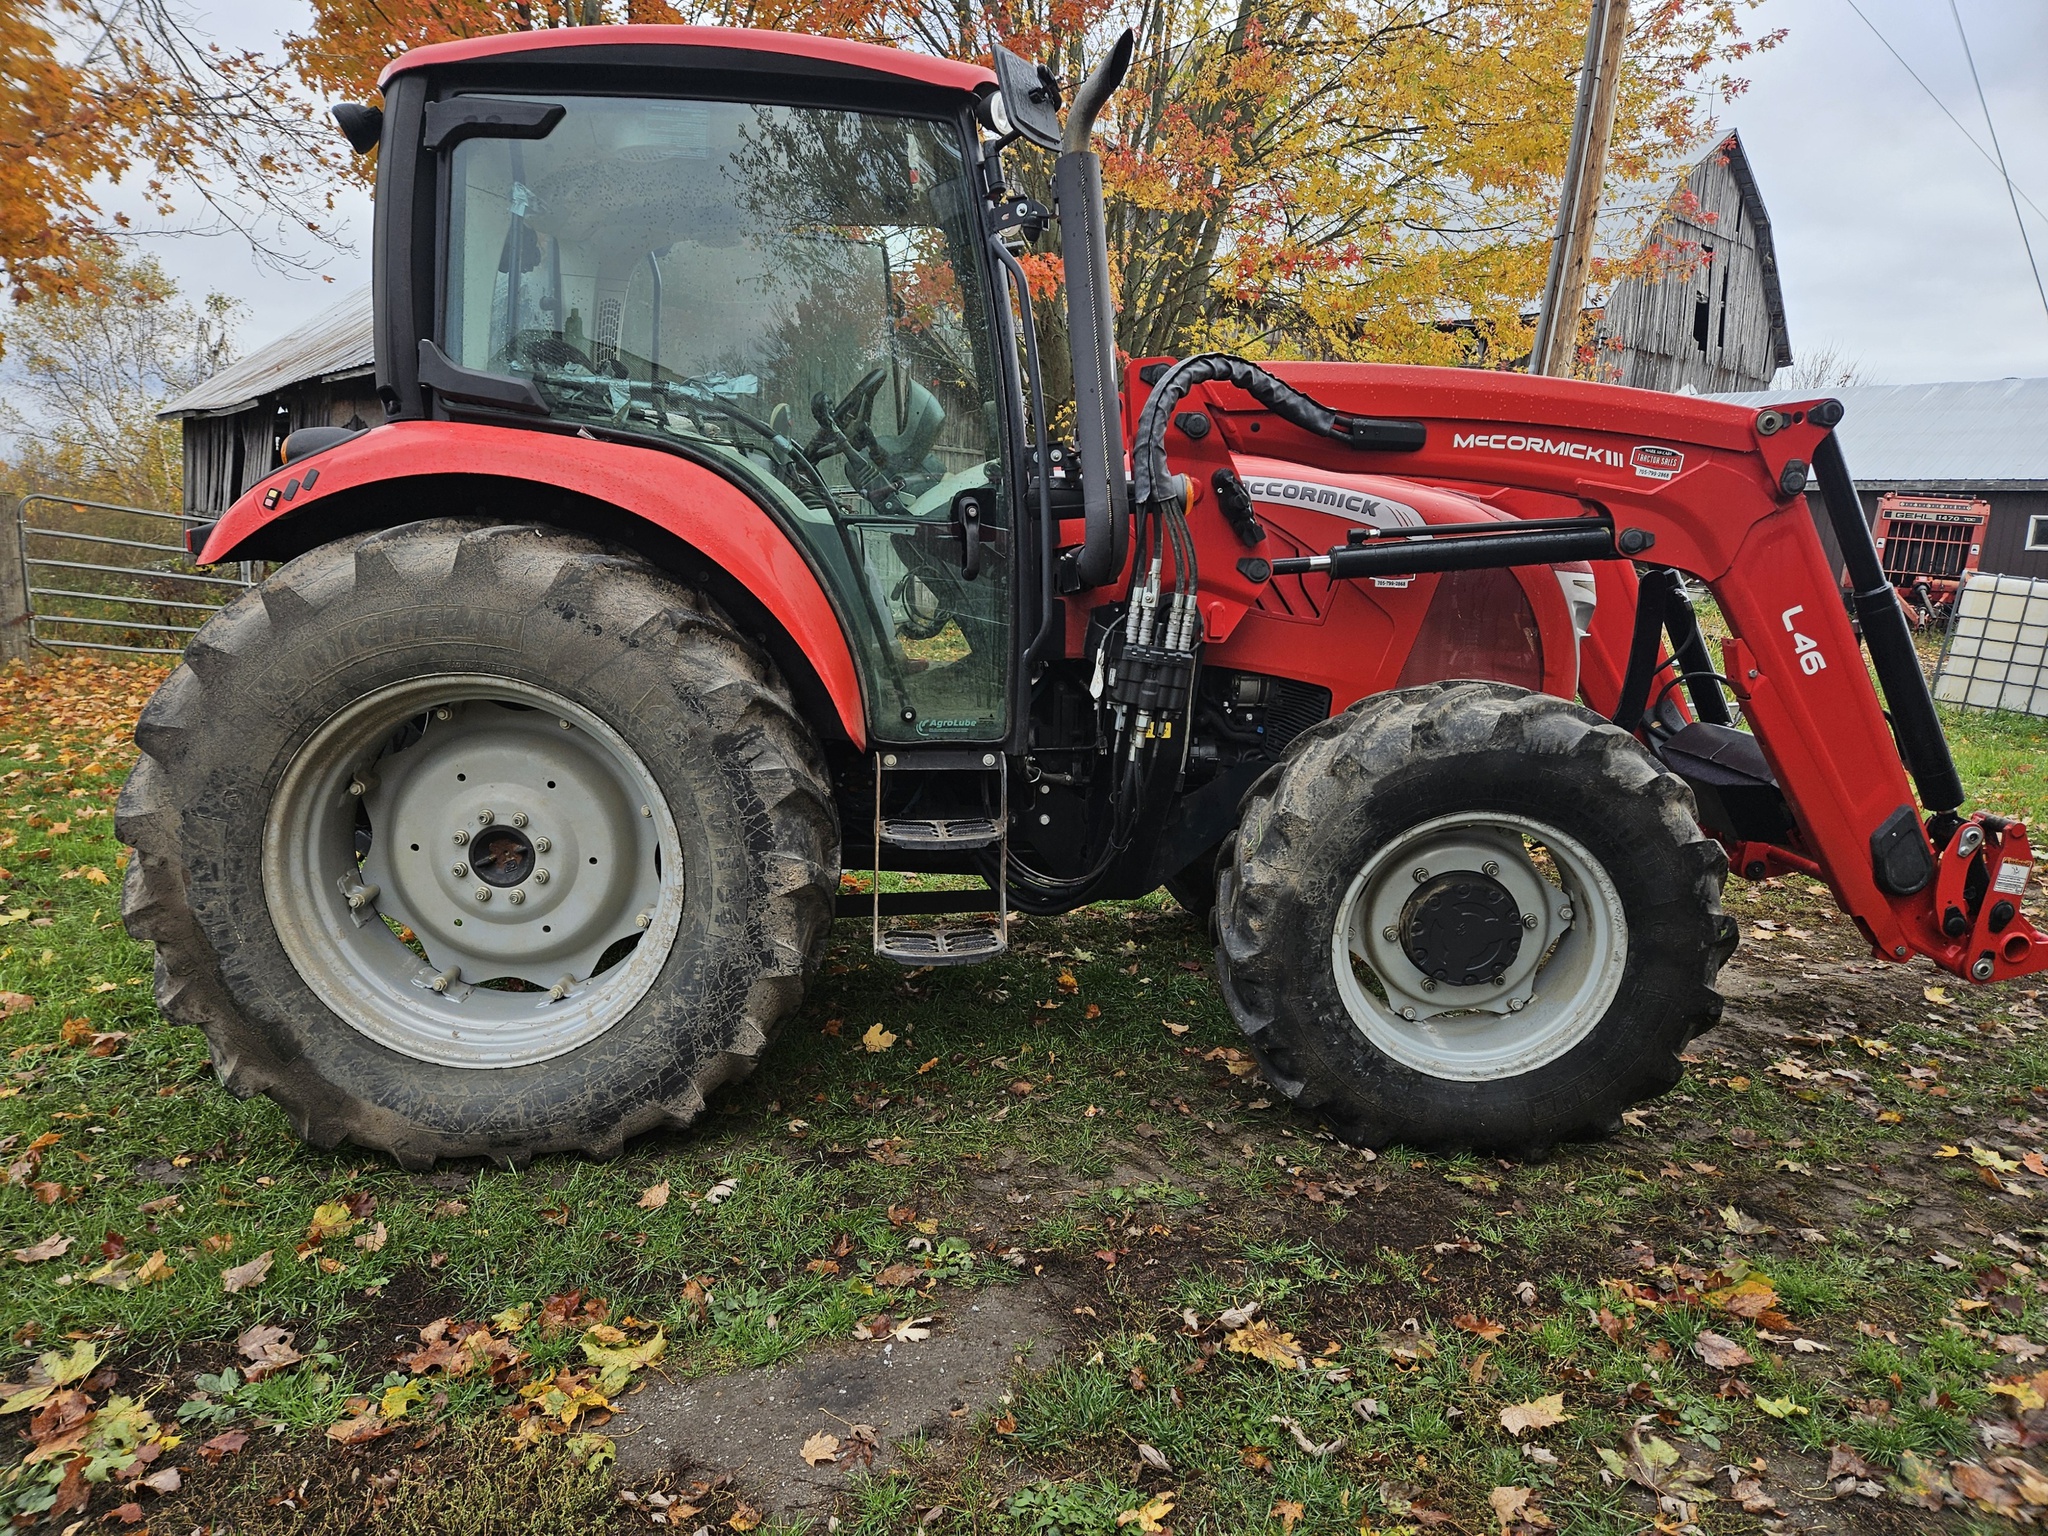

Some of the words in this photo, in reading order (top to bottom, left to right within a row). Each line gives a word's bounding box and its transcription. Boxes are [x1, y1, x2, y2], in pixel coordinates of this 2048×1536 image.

[1637, 453, 1660, 465] TRACTOR
[1660, 457, 1678, 467] SALES
[1895, 512, 1932, 520] GEHL
[1938, 514, 1960, 522] 1470
[1781, 604, 1827, 676] L46
[930, 719, 976, 728] AgroLube
